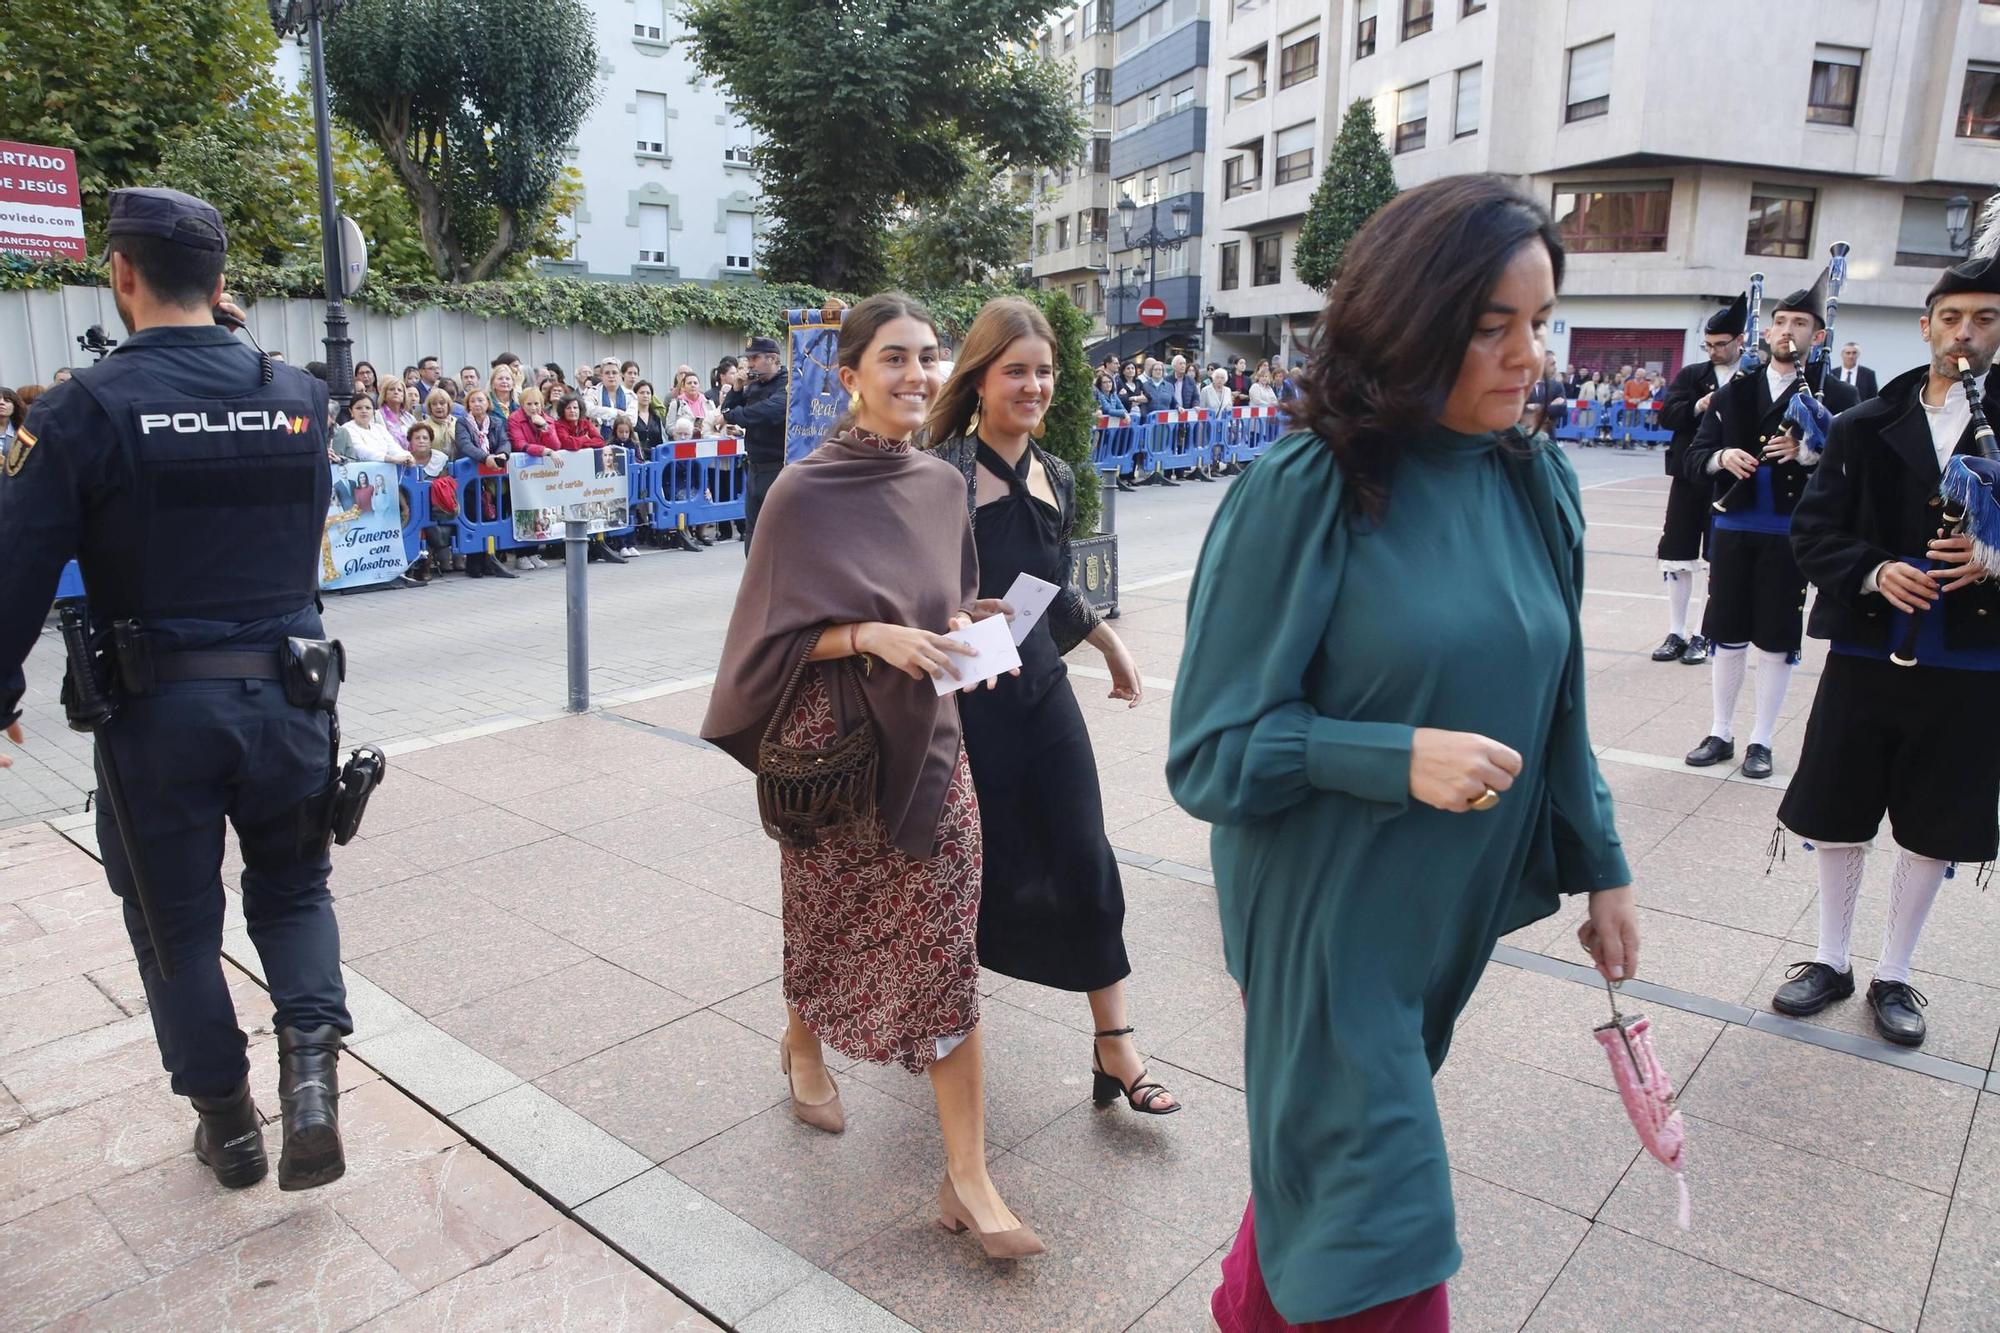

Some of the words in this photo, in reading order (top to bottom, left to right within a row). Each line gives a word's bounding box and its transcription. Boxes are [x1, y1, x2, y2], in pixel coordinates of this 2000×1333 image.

[0, 151, 66, 171] RTADO
[18, 179, 67, 195] JESÚS
[0, 212, 75, 227] oviedo.com
[53, 240, 79, 250] COLL
[140, 410, 293, 434] POLICIA
[369, 545, 391, 555] con
